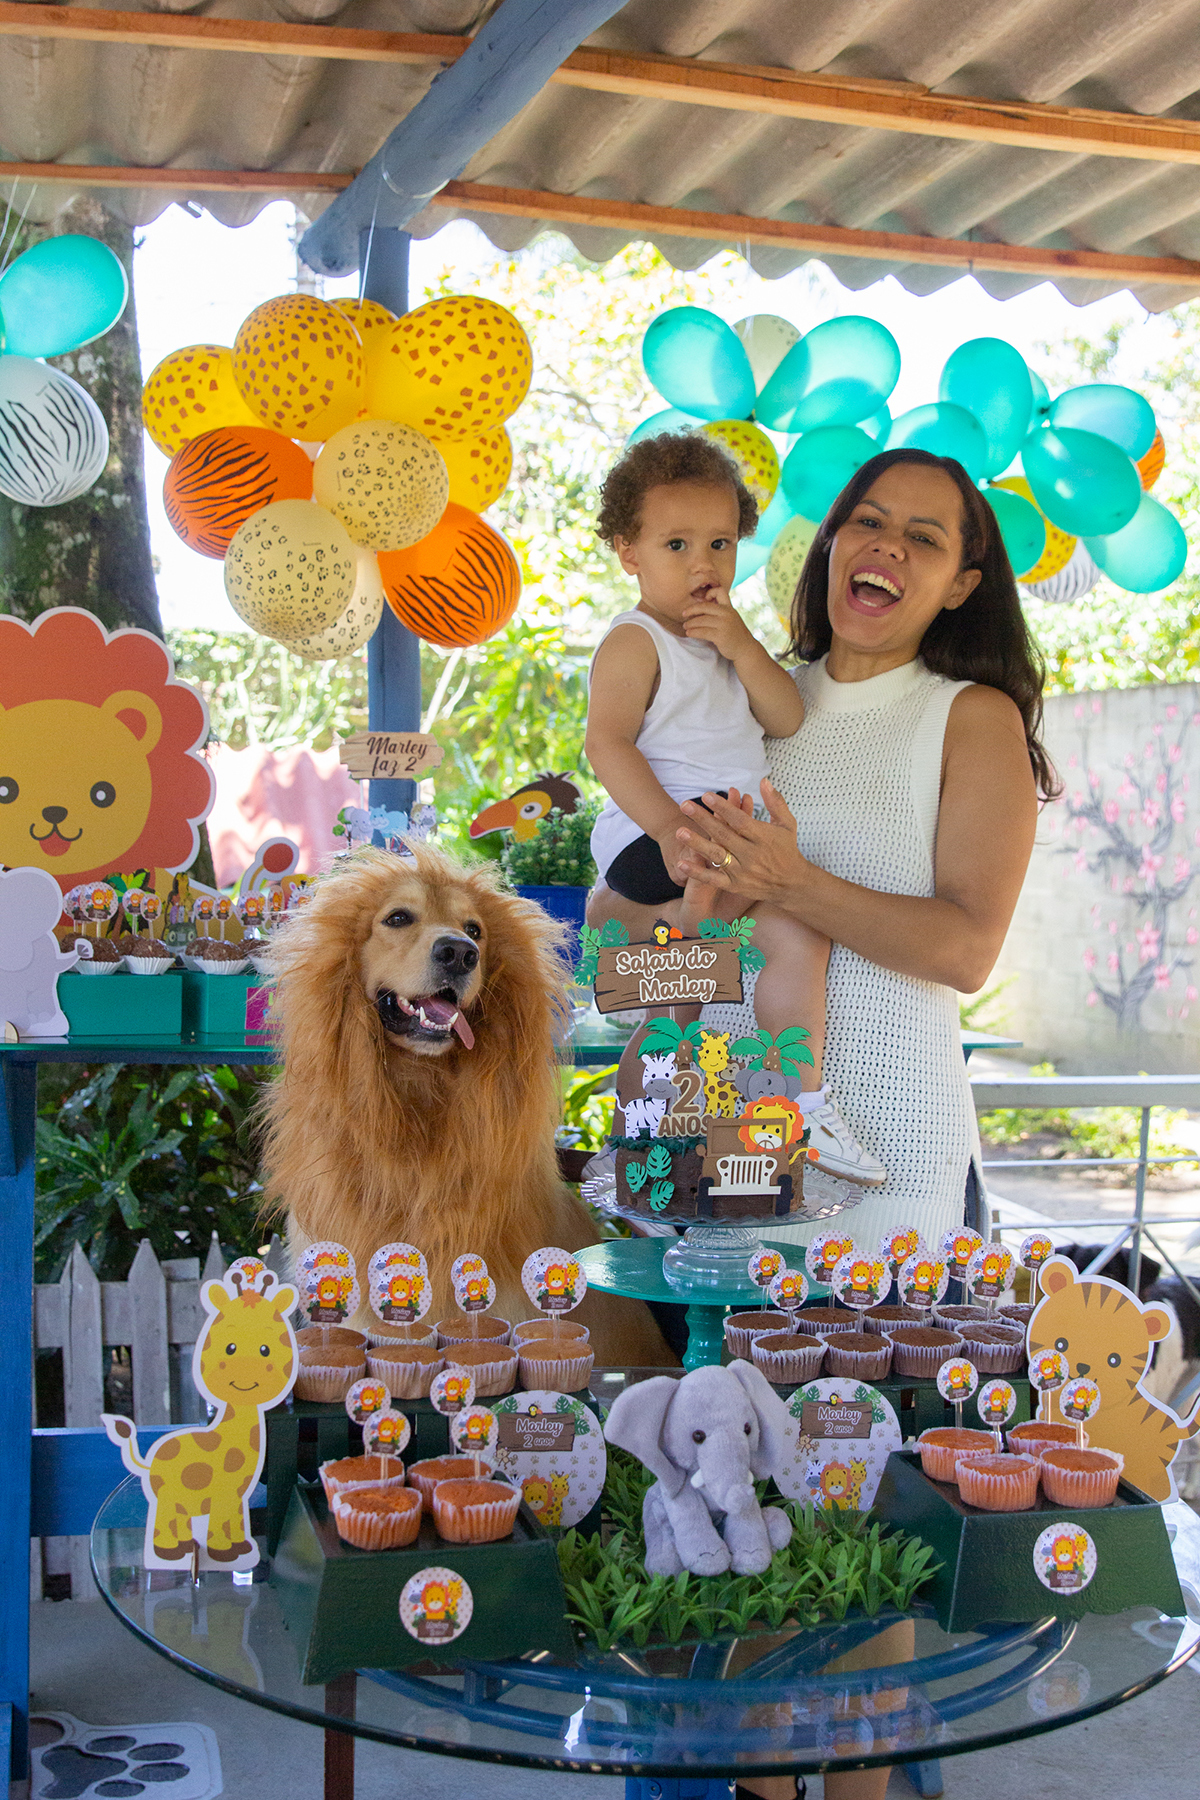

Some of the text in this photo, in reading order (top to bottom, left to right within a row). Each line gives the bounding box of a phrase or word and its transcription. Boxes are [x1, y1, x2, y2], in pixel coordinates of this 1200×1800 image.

[367, 737, 427, 759] Marley
[405, 756, 418, 771] 2
[616, 944, 717, 979] Safari do
[639, 974, 717, 1003] Marley
[671, 1070, 702, 1114] 2
[818, 1407, 861, 1424] Marley
[517, 1418, 563, 1436] Marley
[824, 1422, 853, 1435] 2 anos
[523, 1434, 555, 1448] 2 anos
